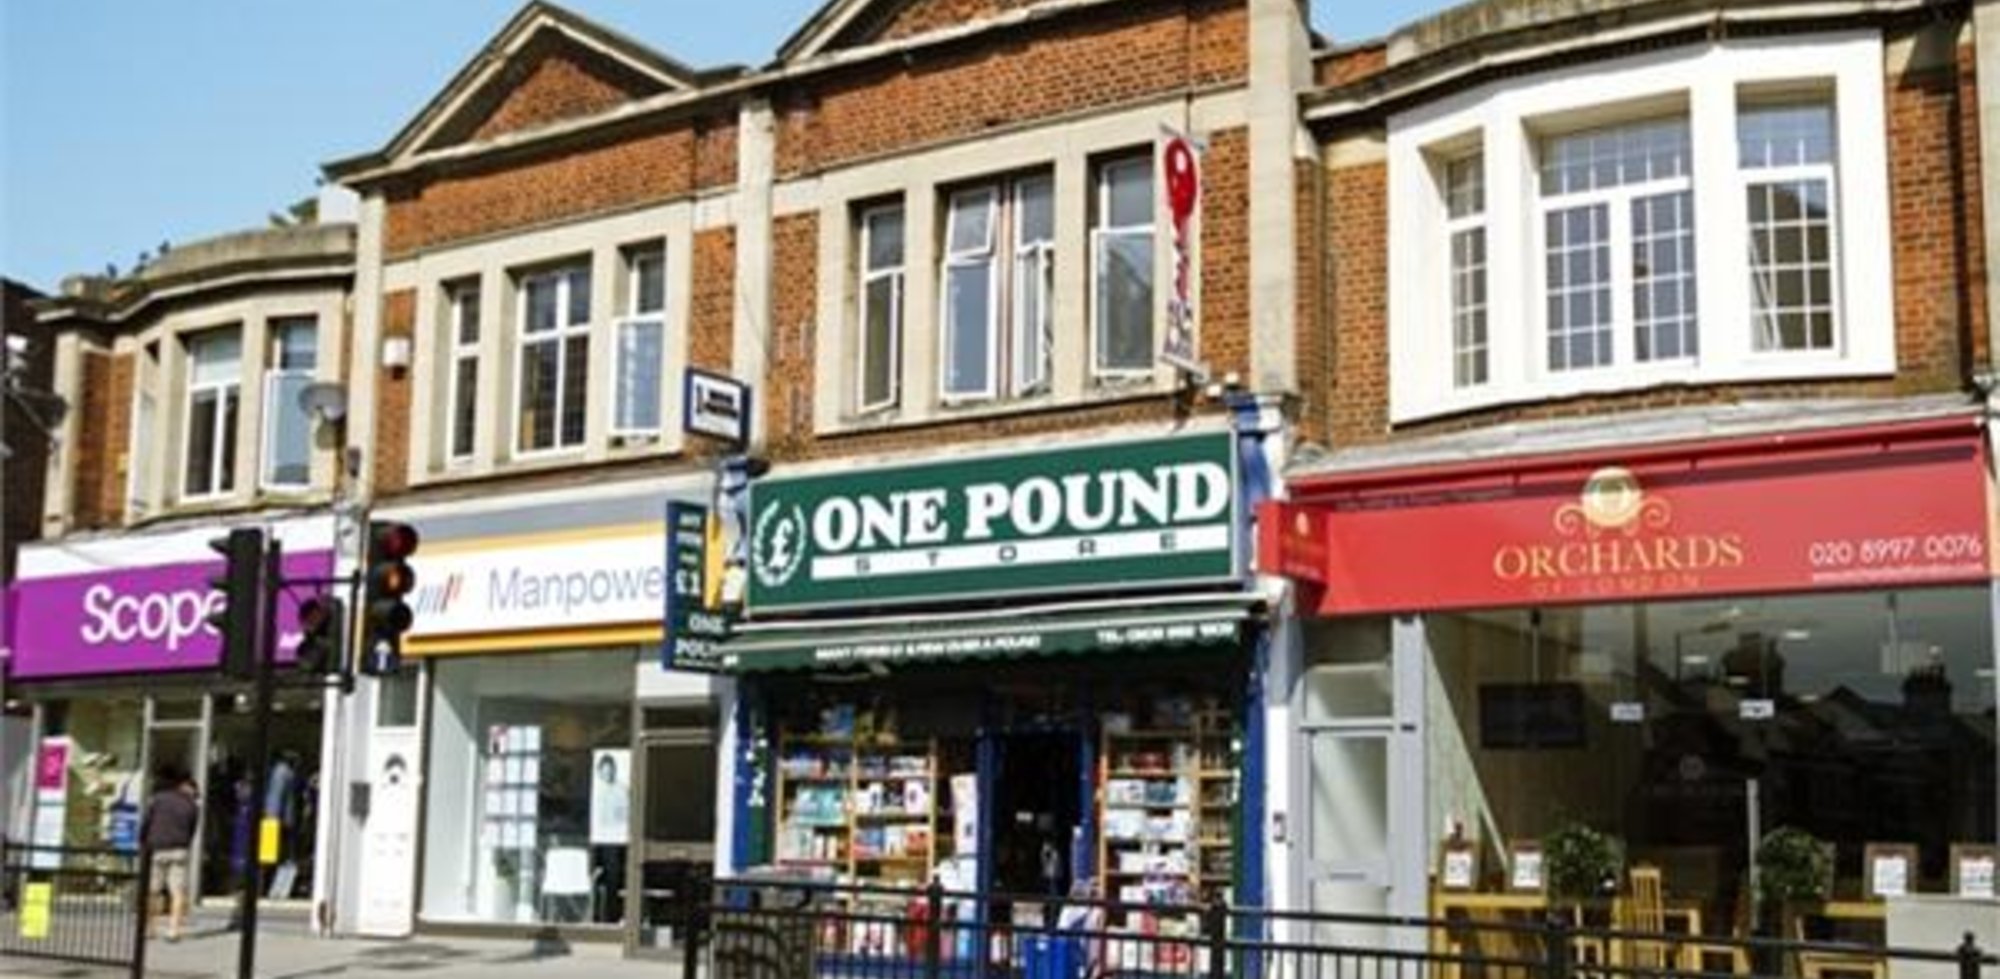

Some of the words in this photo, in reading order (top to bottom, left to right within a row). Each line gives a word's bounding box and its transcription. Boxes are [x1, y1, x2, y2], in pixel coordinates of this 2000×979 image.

[812, 493, 948, 552] ONE
[964, 461, 1229, 541] POUND
[854, 531, 1178, 574] STORE
[1493, 533, 1745, 581] ORCHARDS
[1809, 539, 1853, 567] 020
[1924, 532, 1983, 559] 0076
[80, 582, 228, 650] Scope
[489, 565, 664, 617] Manpowe
